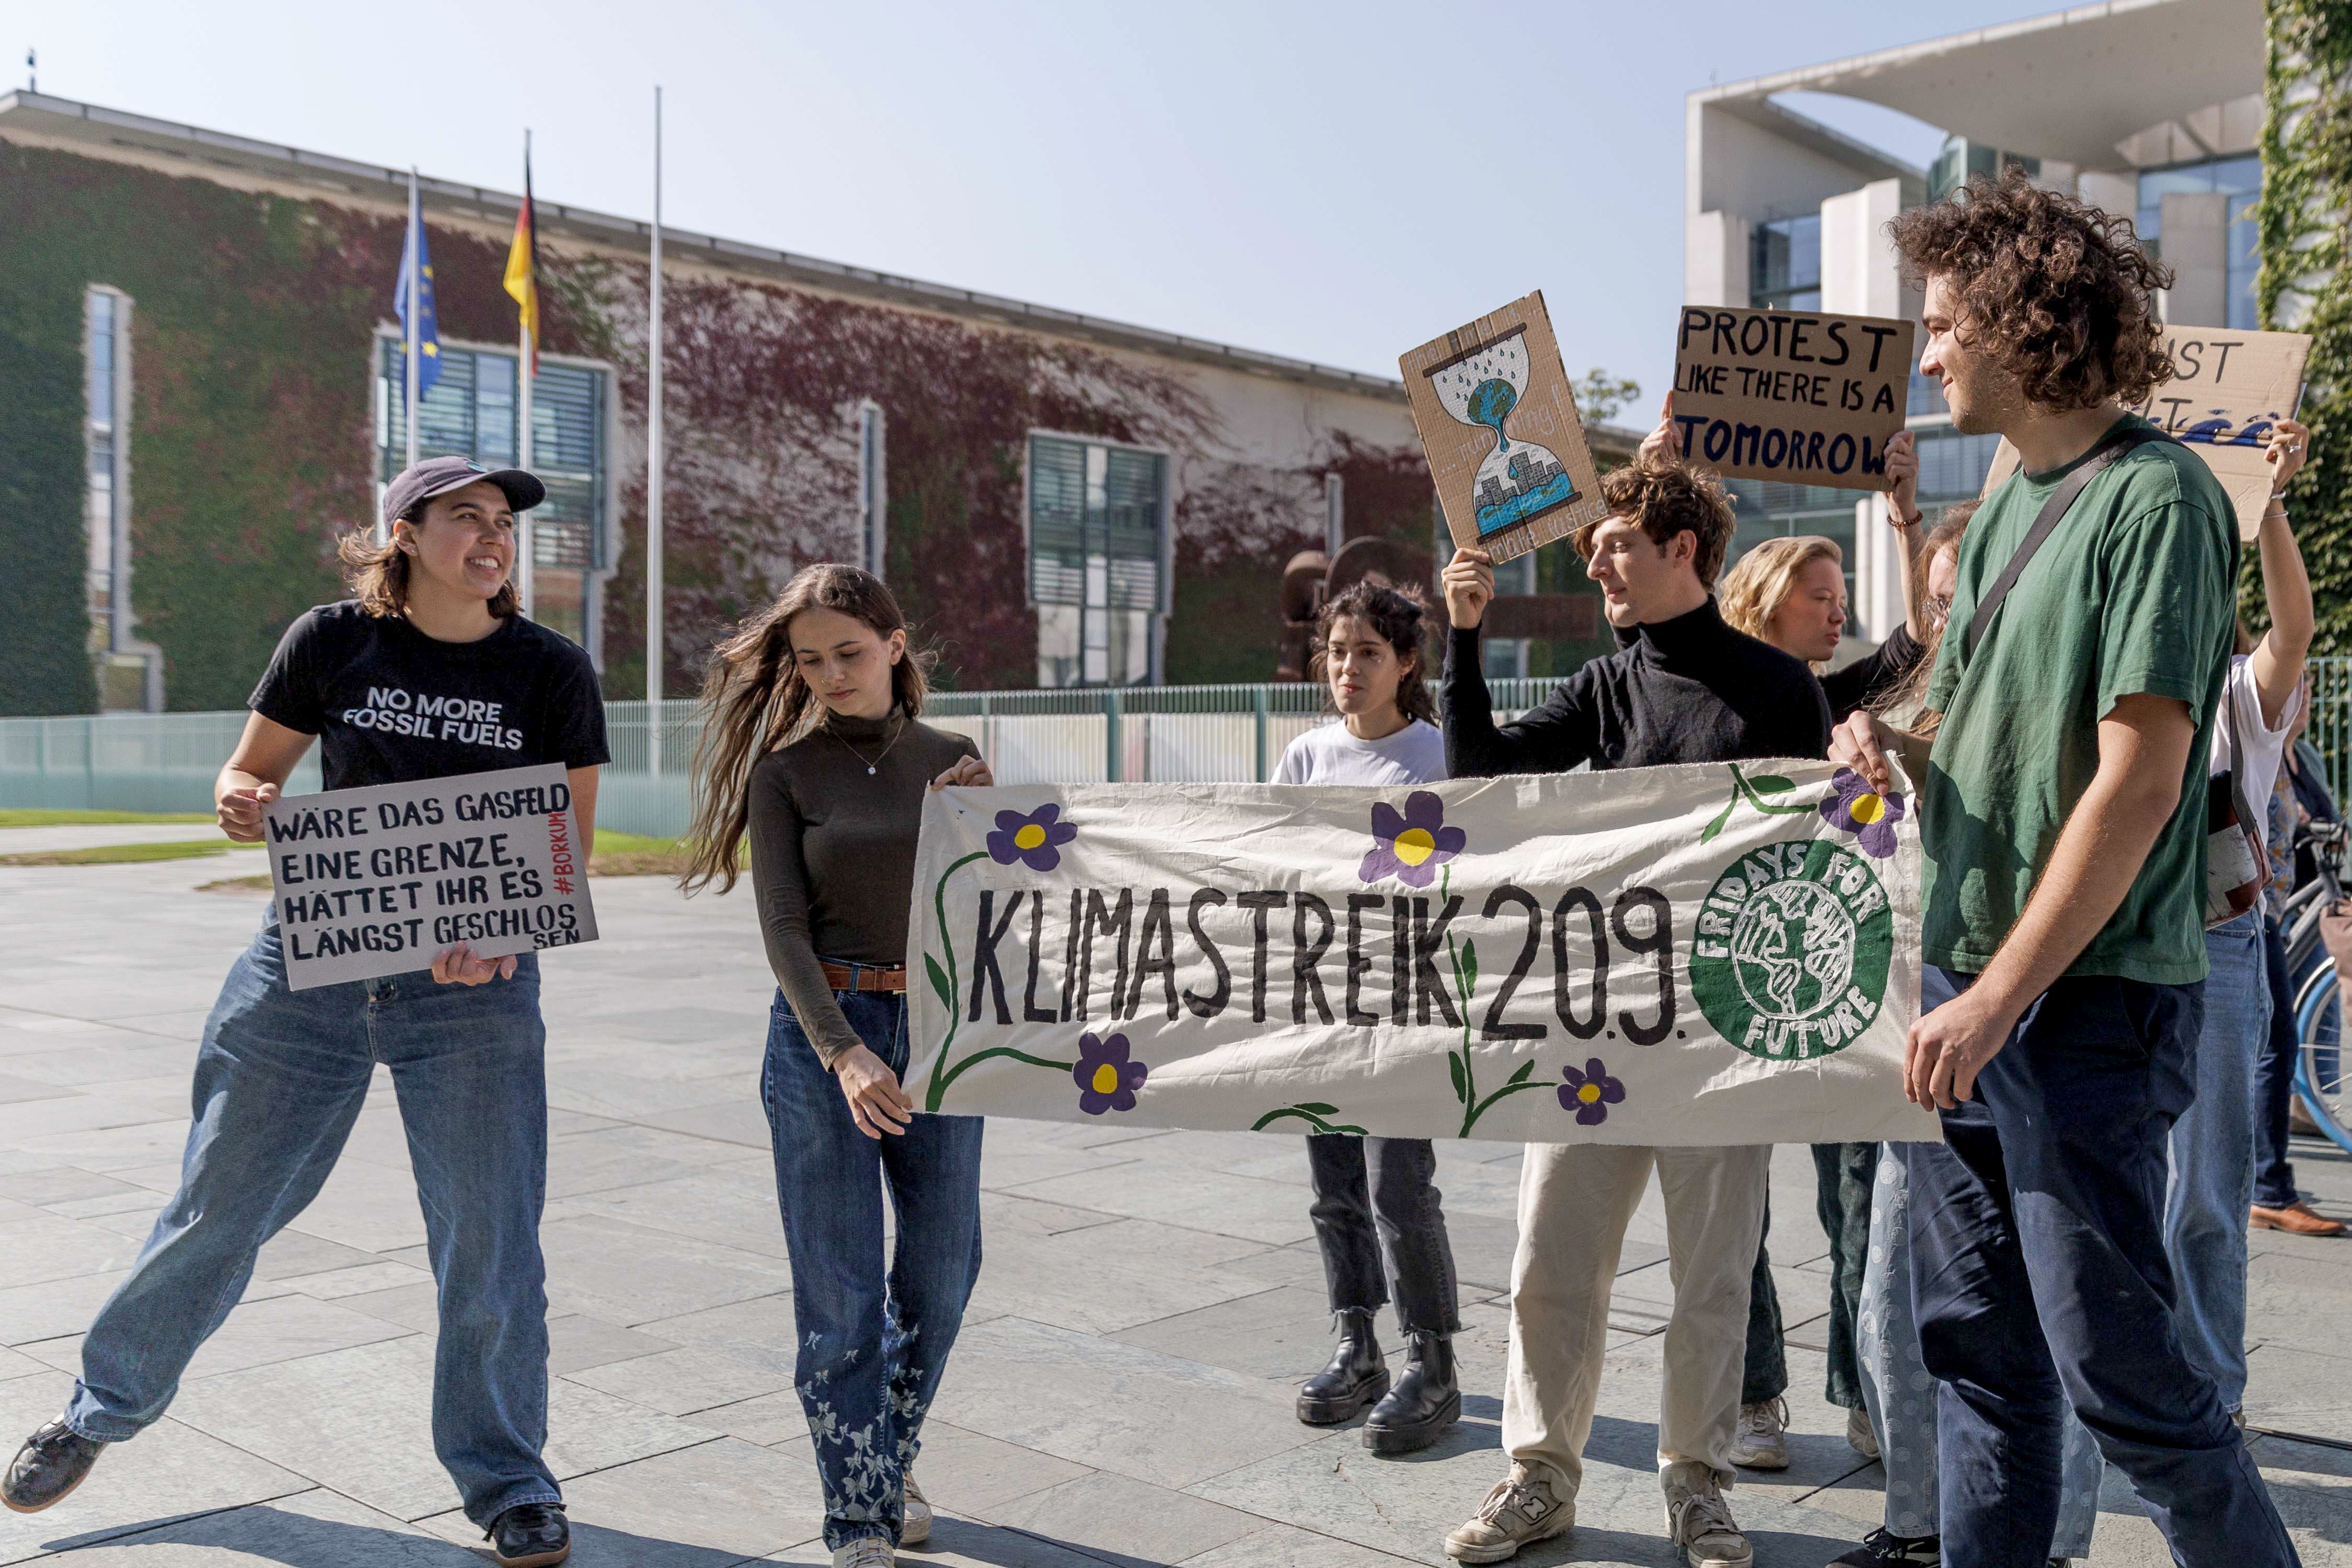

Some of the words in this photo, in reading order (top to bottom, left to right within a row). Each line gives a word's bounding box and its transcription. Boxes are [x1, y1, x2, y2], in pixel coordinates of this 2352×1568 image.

[1681, 309, 1898, 372] PROTEST
[1674, 362, 1729, 395] LIKE
[1735, 367, 1830, 407] THERE
[1841, 378, 1864, 411] IS
[1871, 383, 1895, 413] A
[1675, 414, 1888, 476] TOMORROW
[343, 708, 434, 739] FOSSIL
[441, 719, 523, 751] FUELS
[367, 686, 411, 711] NO
[416, 695, 502, 723] MORE
[269, 806, 368, 843] WÄRE
[379, 798, 445, 829] DAS
[455, 783, 570, 821] GASFELD
[280, 850, 362, 884] EINE
[371, 833, 526, 877] GRENZE,
[547, 811, 575, 895] #BORKUM
[284, 882, 423, 924] HÄTTET
[437, 877, 488, 906] IHR
[502, 869, 544, 899] ES
[1697, 843, 1808, 958] FRIDAYS
[1821, 852, 1885, 924] FOR
[291, 918, 424, 962] LÄNGST
[434, 903, 577, 945] GESCHLOS
[532, 928, 581, 950] SEN
[968, 887, 1465, 1029] KLIMASTREIK
[1481, 883, 1687, 1045] 20.9.
[1742, 985, 1877, 1058] FUTURE
